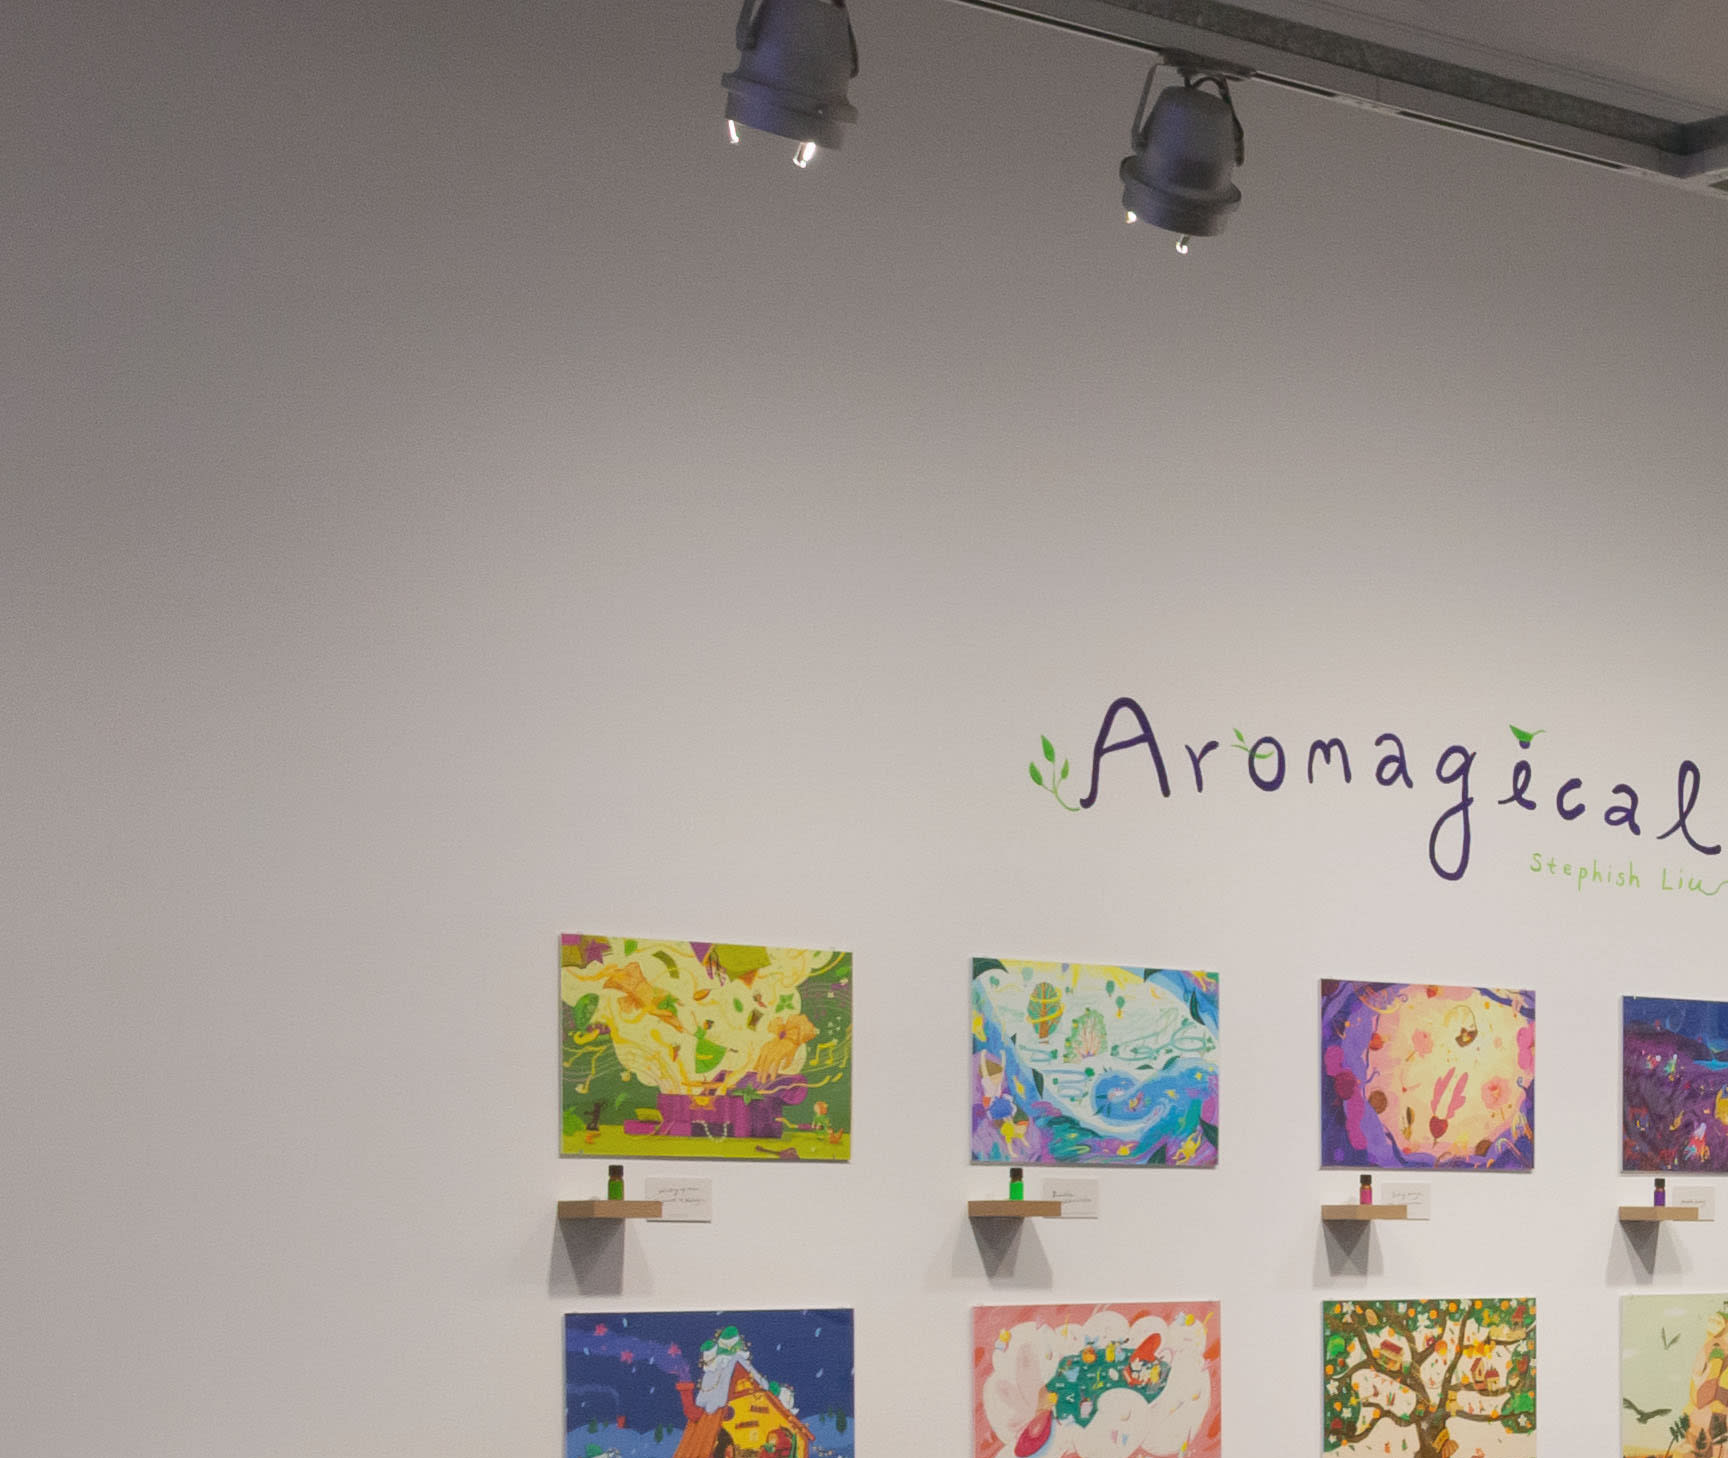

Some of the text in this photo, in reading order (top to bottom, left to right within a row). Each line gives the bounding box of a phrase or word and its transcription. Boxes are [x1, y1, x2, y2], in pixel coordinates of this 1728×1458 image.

[1080, 697, 1721, 881] Aromagical
[1530, 853, 1702, 891] Stephish Liu
